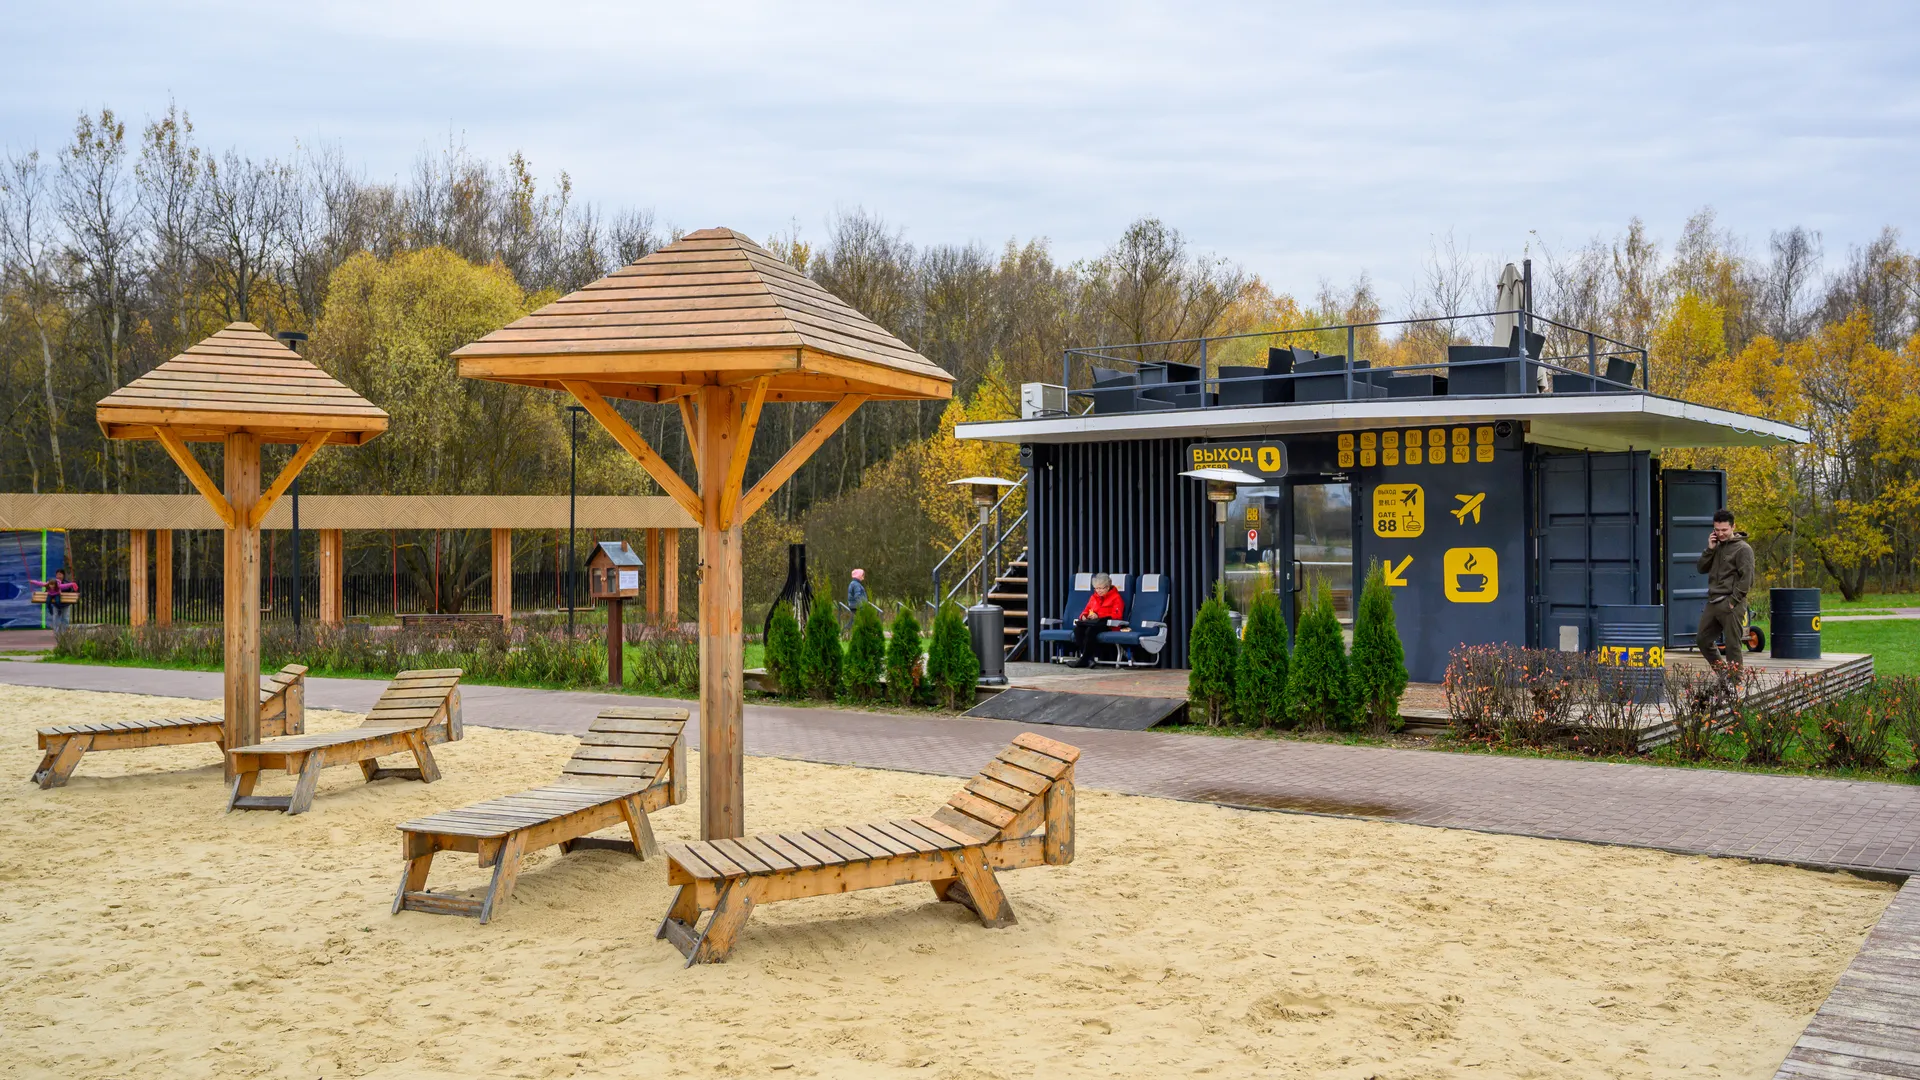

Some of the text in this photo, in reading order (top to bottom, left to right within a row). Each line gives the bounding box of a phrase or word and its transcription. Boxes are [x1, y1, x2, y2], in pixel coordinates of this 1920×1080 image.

[1193, 447, 1254, 463] ВЫХОД
[1377, 519, 1397, 532] 88
[1597, 645, 1645, 667] ATE
